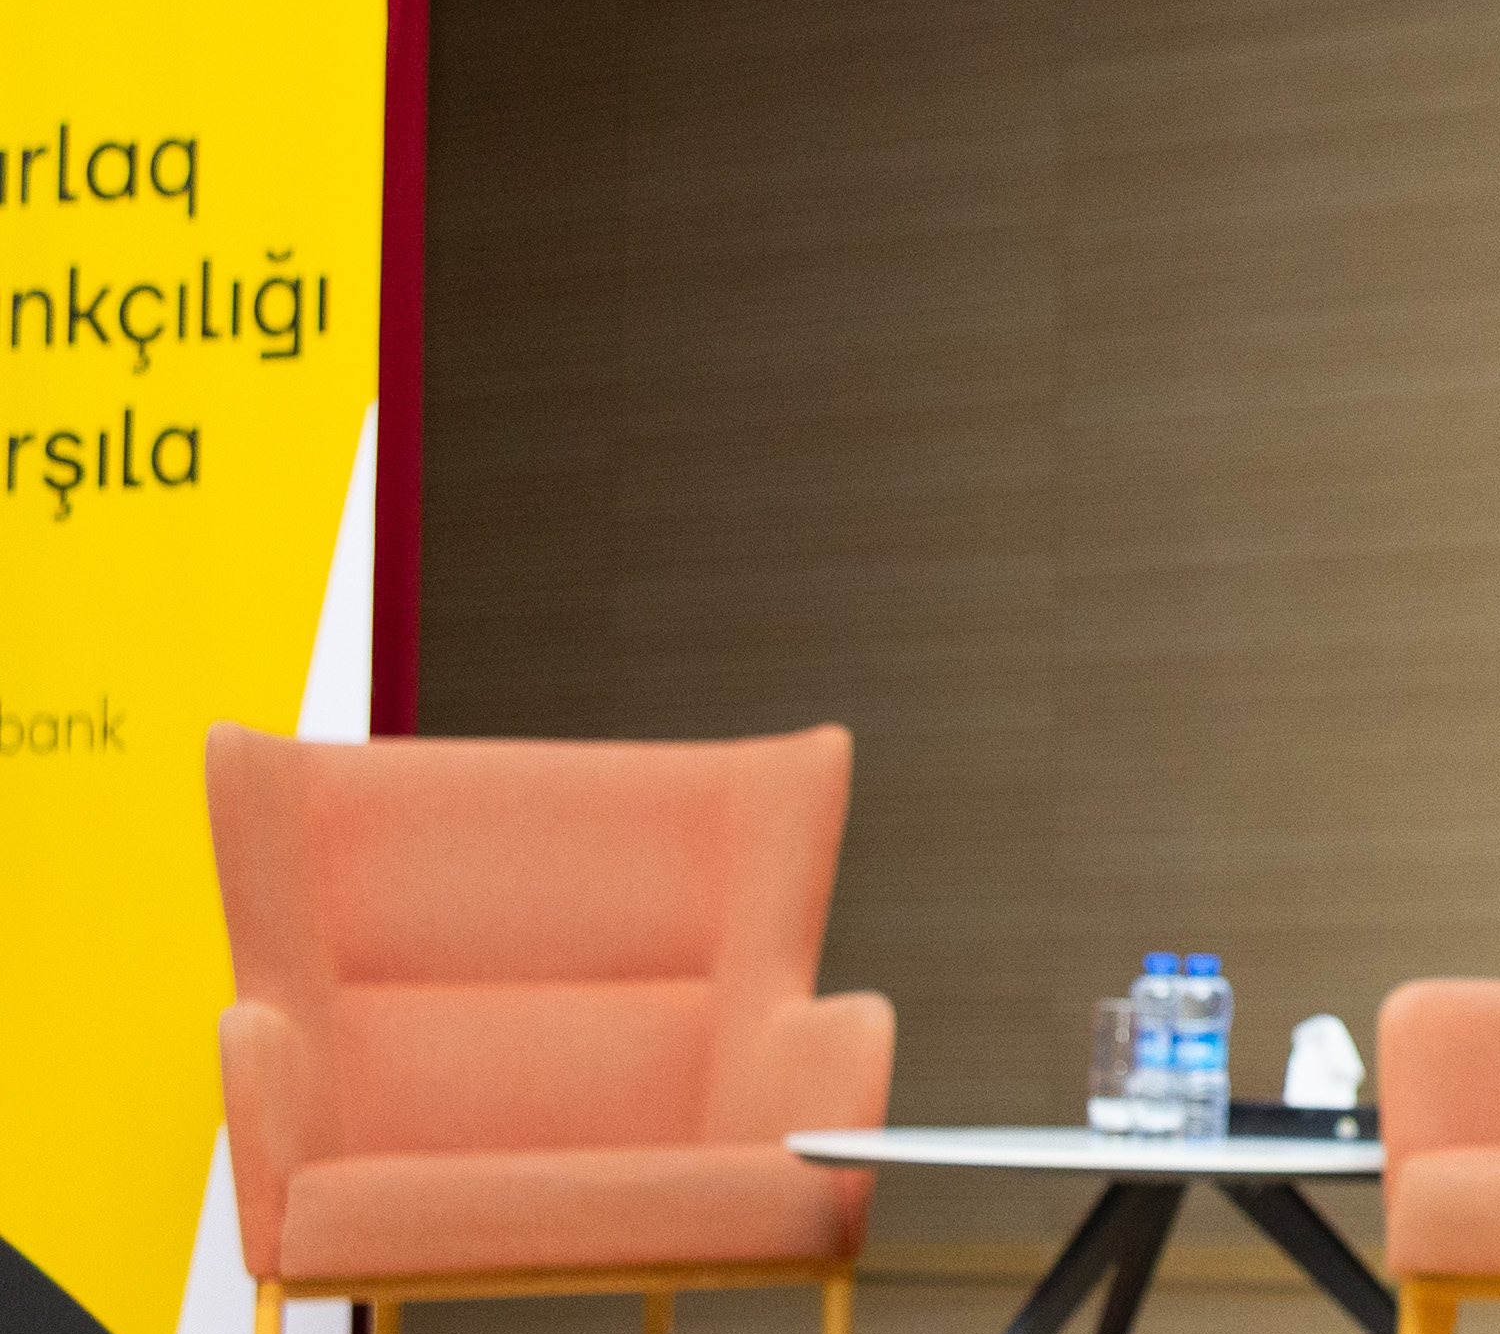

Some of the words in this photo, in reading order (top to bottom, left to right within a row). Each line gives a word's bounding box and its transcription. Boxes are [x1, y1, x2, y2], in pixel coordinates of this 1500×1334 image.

[0, 122, 198, 219] rlaq
[9, 247, 330, 375] nkçılığı
[5, 406, 201, 521] rşıla
[0, 693, 127, 757] bank
